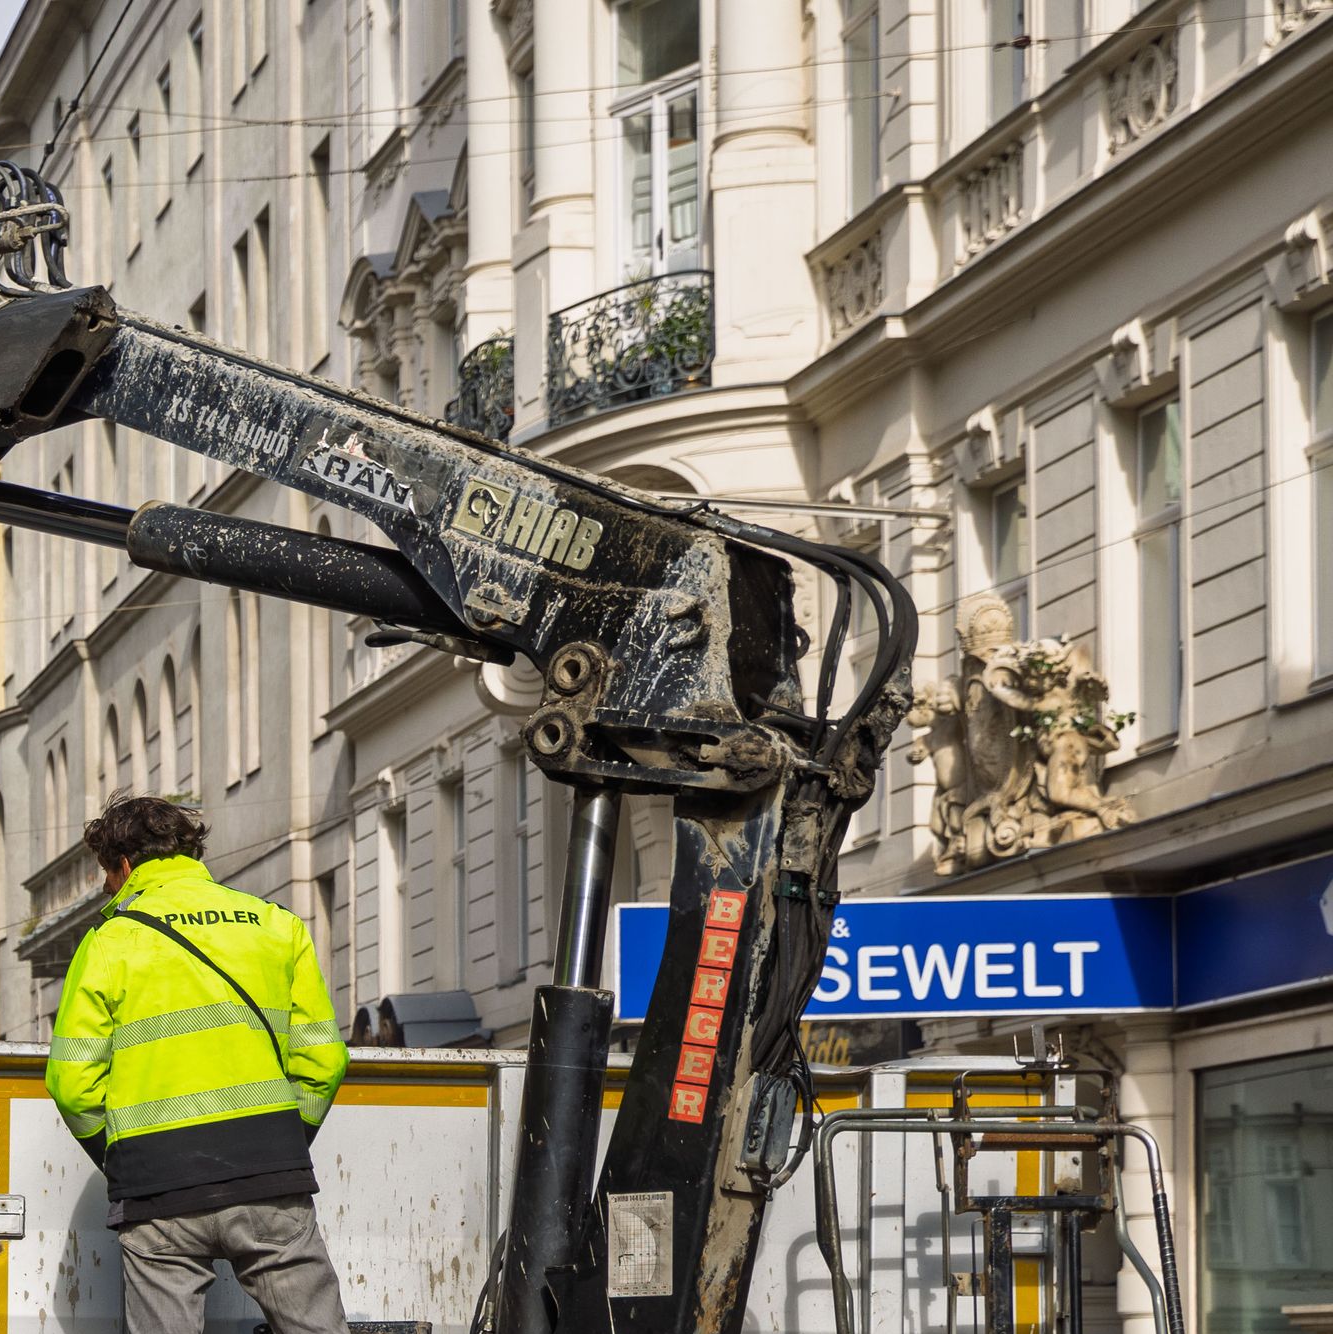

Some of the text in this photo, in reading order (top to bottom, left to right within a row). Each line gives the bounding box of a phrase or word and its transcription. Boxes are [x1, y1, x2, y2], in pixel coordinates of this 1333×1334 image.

[195, 403, 230, 437] 144
[503, 494, 604, 571] HIAB
[155, 910, 261, 926] PINDLER
[831, 917, 851, 938] &
[812, 941, 1100, 1002] SEWELT
[674, 894, 743, 1118] BERGER
